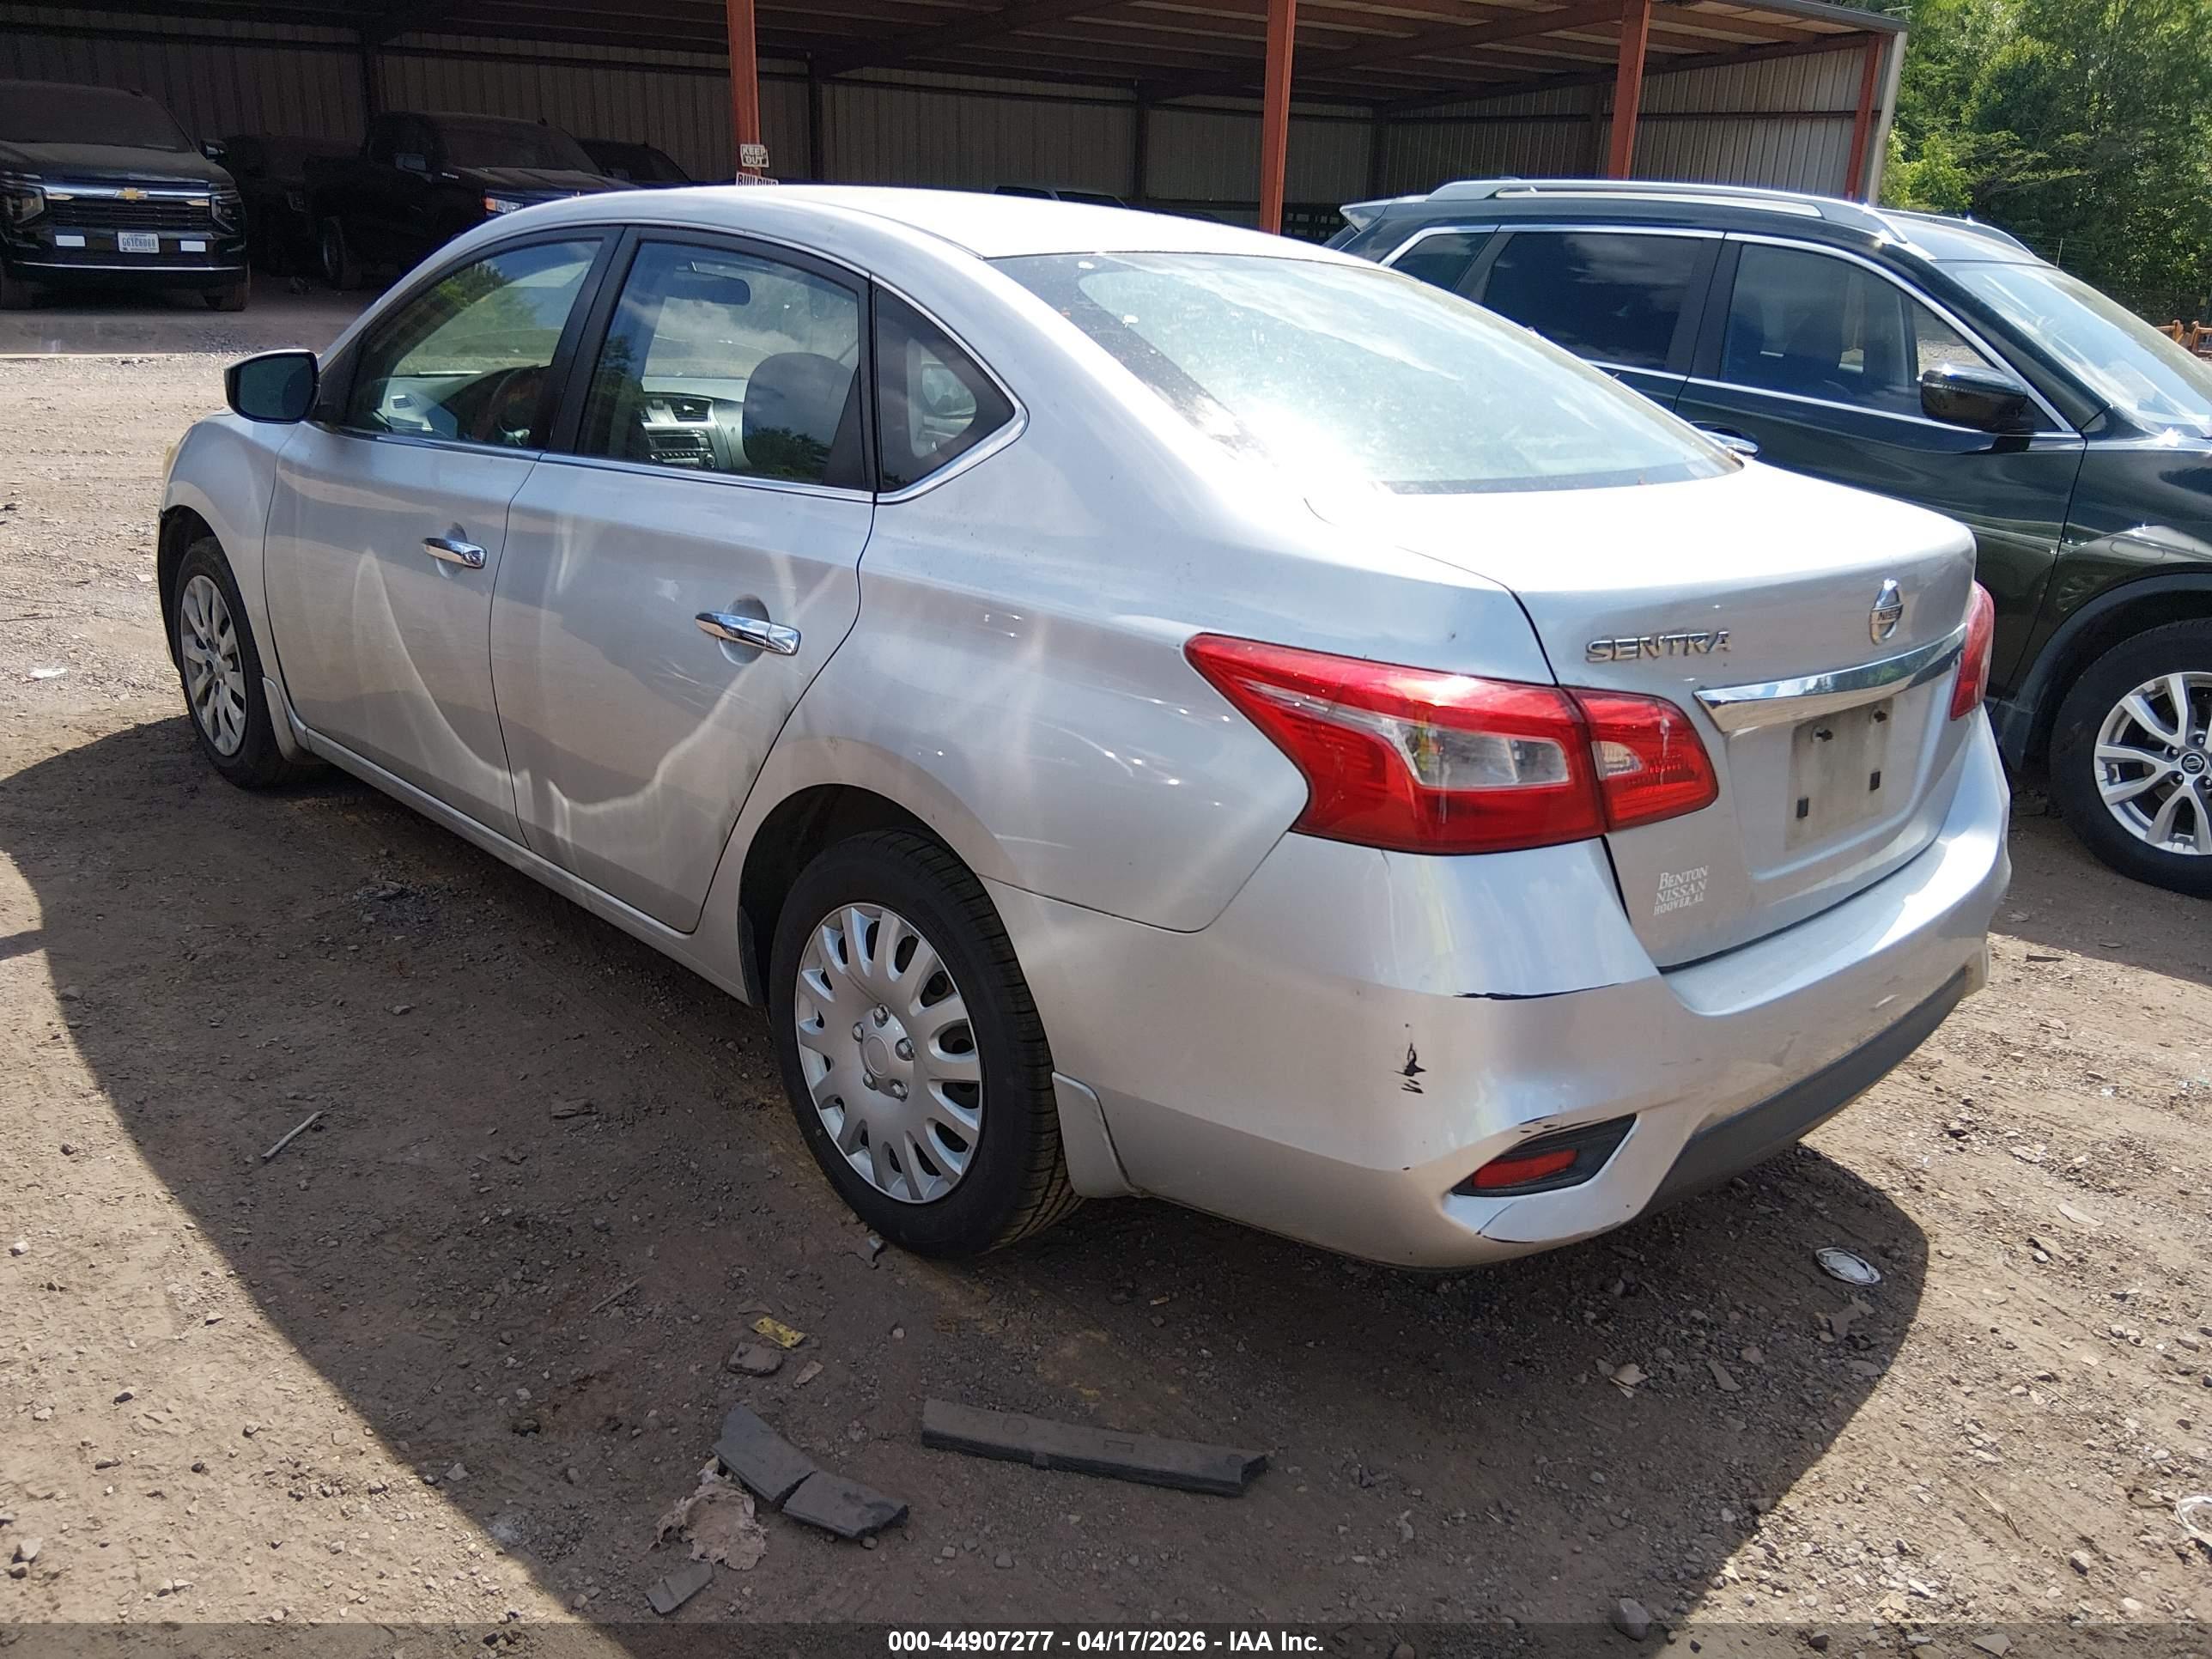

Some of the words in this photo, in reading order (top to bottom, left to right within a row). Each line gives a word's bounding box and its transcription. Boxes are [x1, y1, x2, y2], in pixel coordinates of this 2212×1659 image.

[742, 146, 766, 155] KEEP
[744, 155, 763, 165] OUT
[1585, 630, 1731, 663] SENTRA
[1658, 865, 1708, 890] BENTON
[1655, 879, 1707, 904] NISSAN
